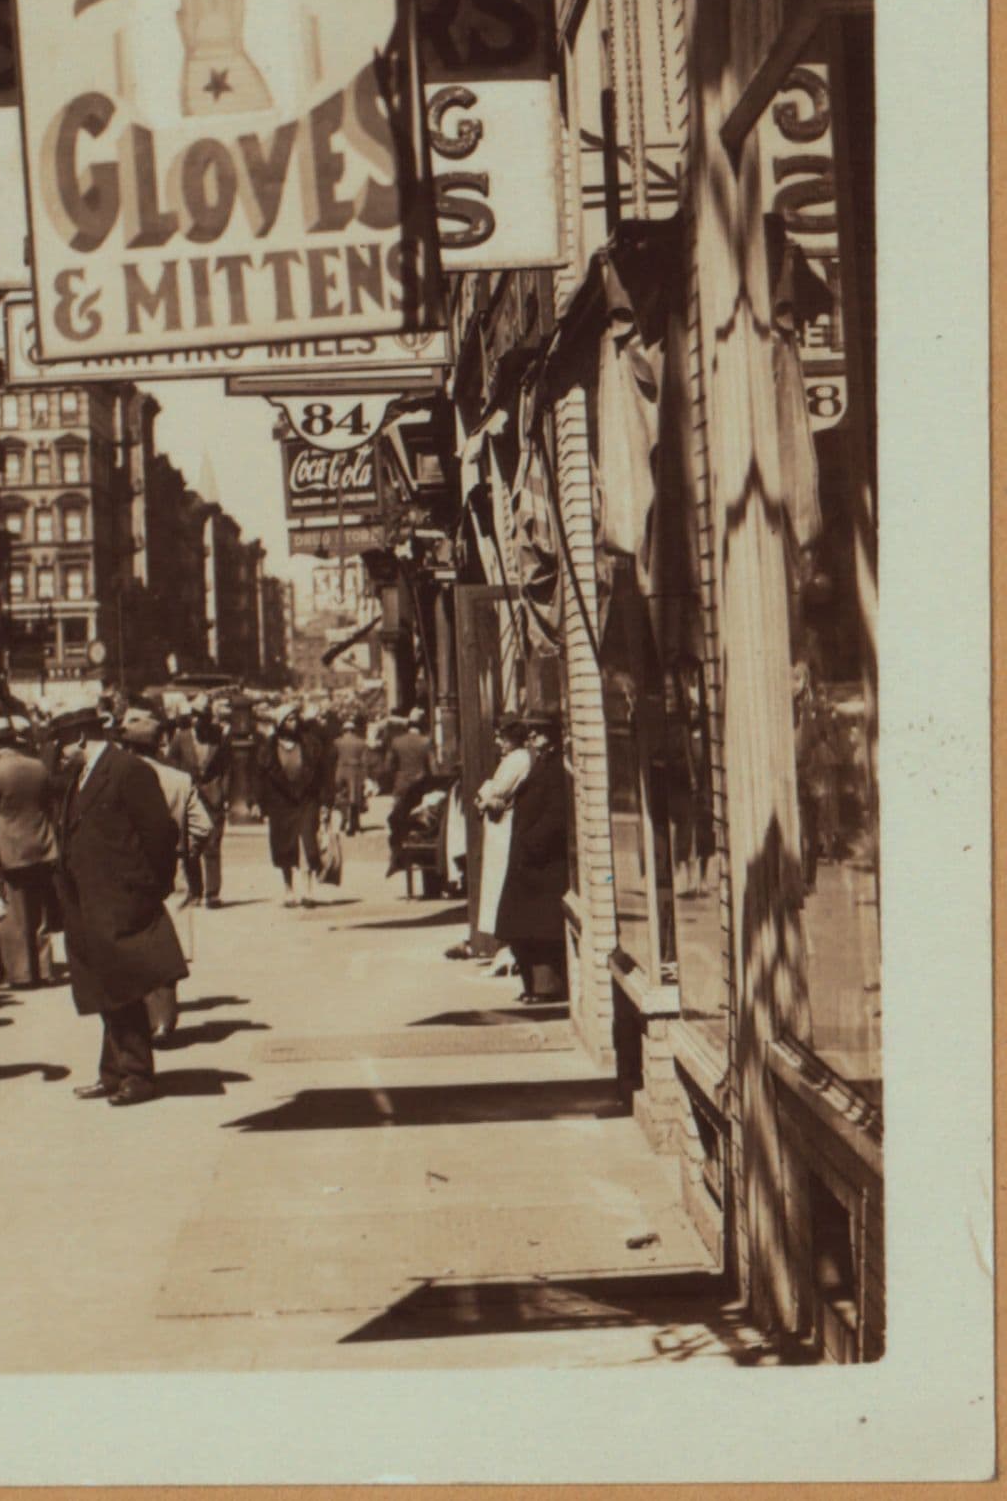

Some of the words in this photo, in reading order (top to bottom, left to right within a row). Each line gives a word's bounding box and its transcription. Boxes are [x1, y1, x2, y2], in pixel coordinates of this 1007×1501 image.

[42, 57, 403, 253] GLOVES
[54, 267, 103, 342] &
[123, 241, 420, 336] MITTENS
[300, 402, 371, 437] 84
